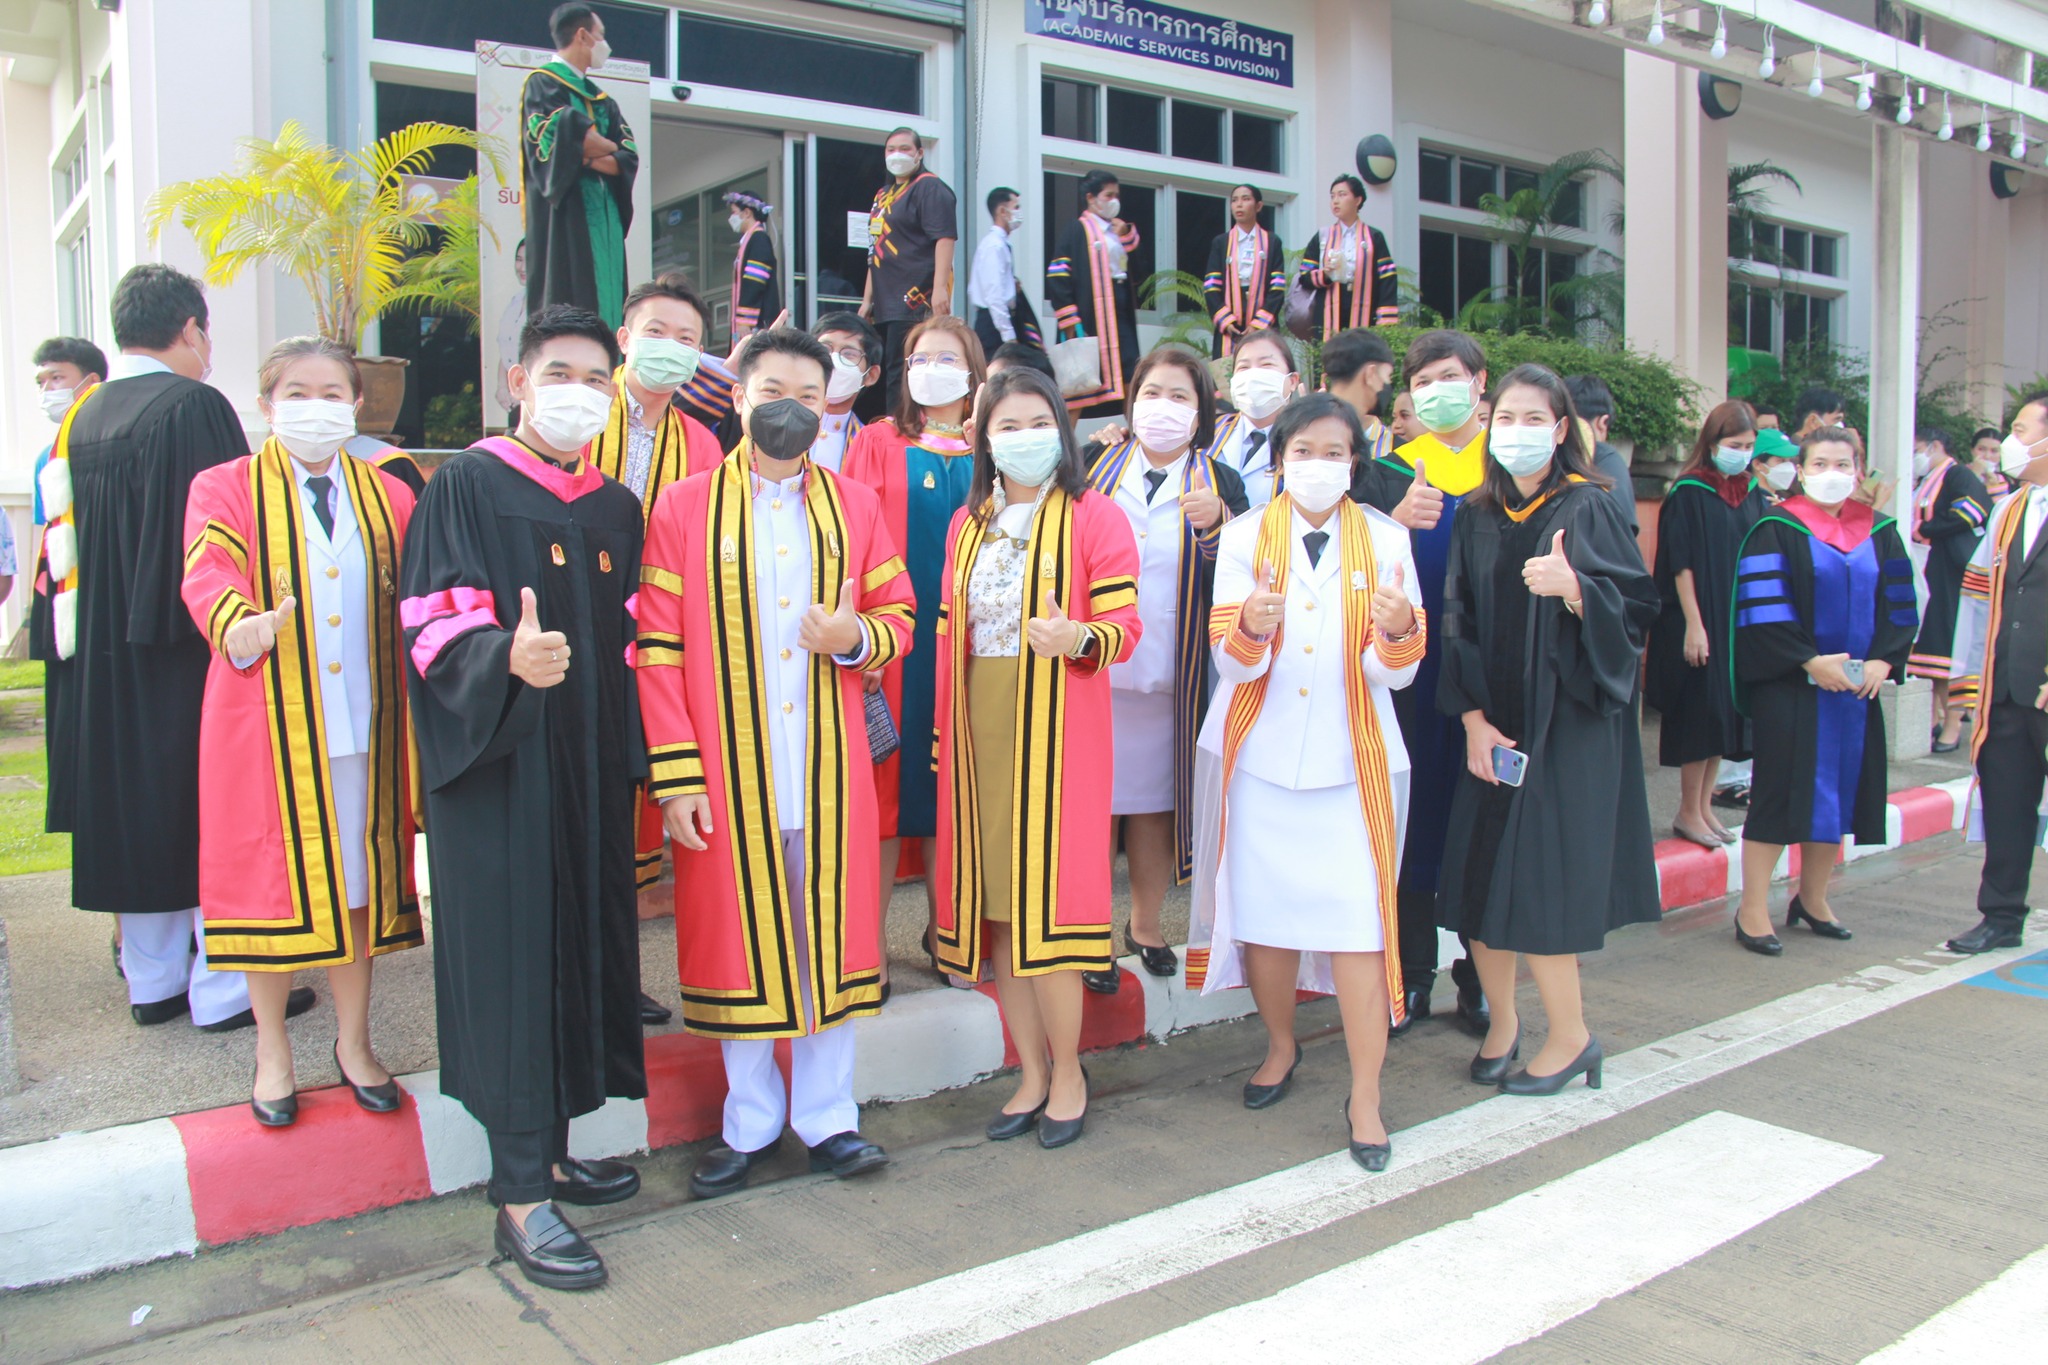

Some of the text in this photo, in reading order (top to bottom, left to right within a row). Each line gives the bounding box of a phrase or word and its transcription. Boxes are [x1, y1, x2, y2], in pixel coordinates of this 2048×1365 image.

[1043, 18, 1280, 81] (ACADEMIC SERVICES DIVISION)
